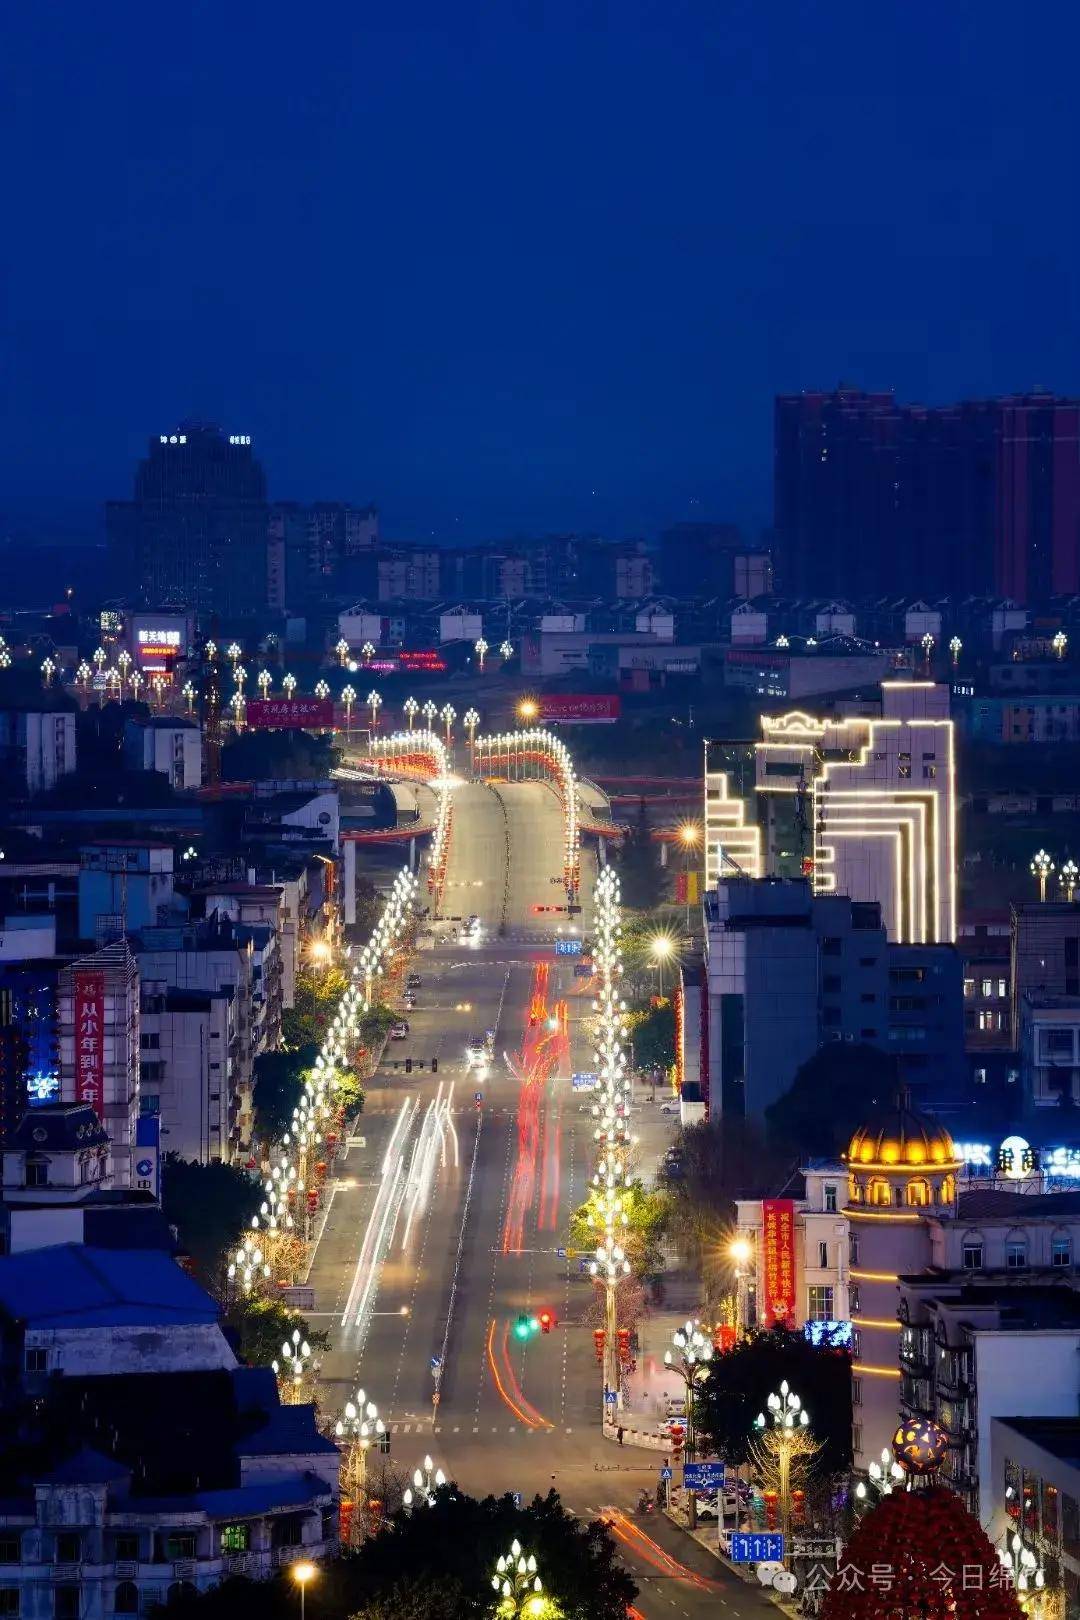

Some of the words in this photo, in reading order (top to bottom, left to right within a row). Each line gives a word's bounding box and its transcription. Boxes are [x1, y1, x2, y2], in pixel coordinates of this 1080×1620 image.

[780, 1213, 792, 1297] 祝全市人民新年快乐
